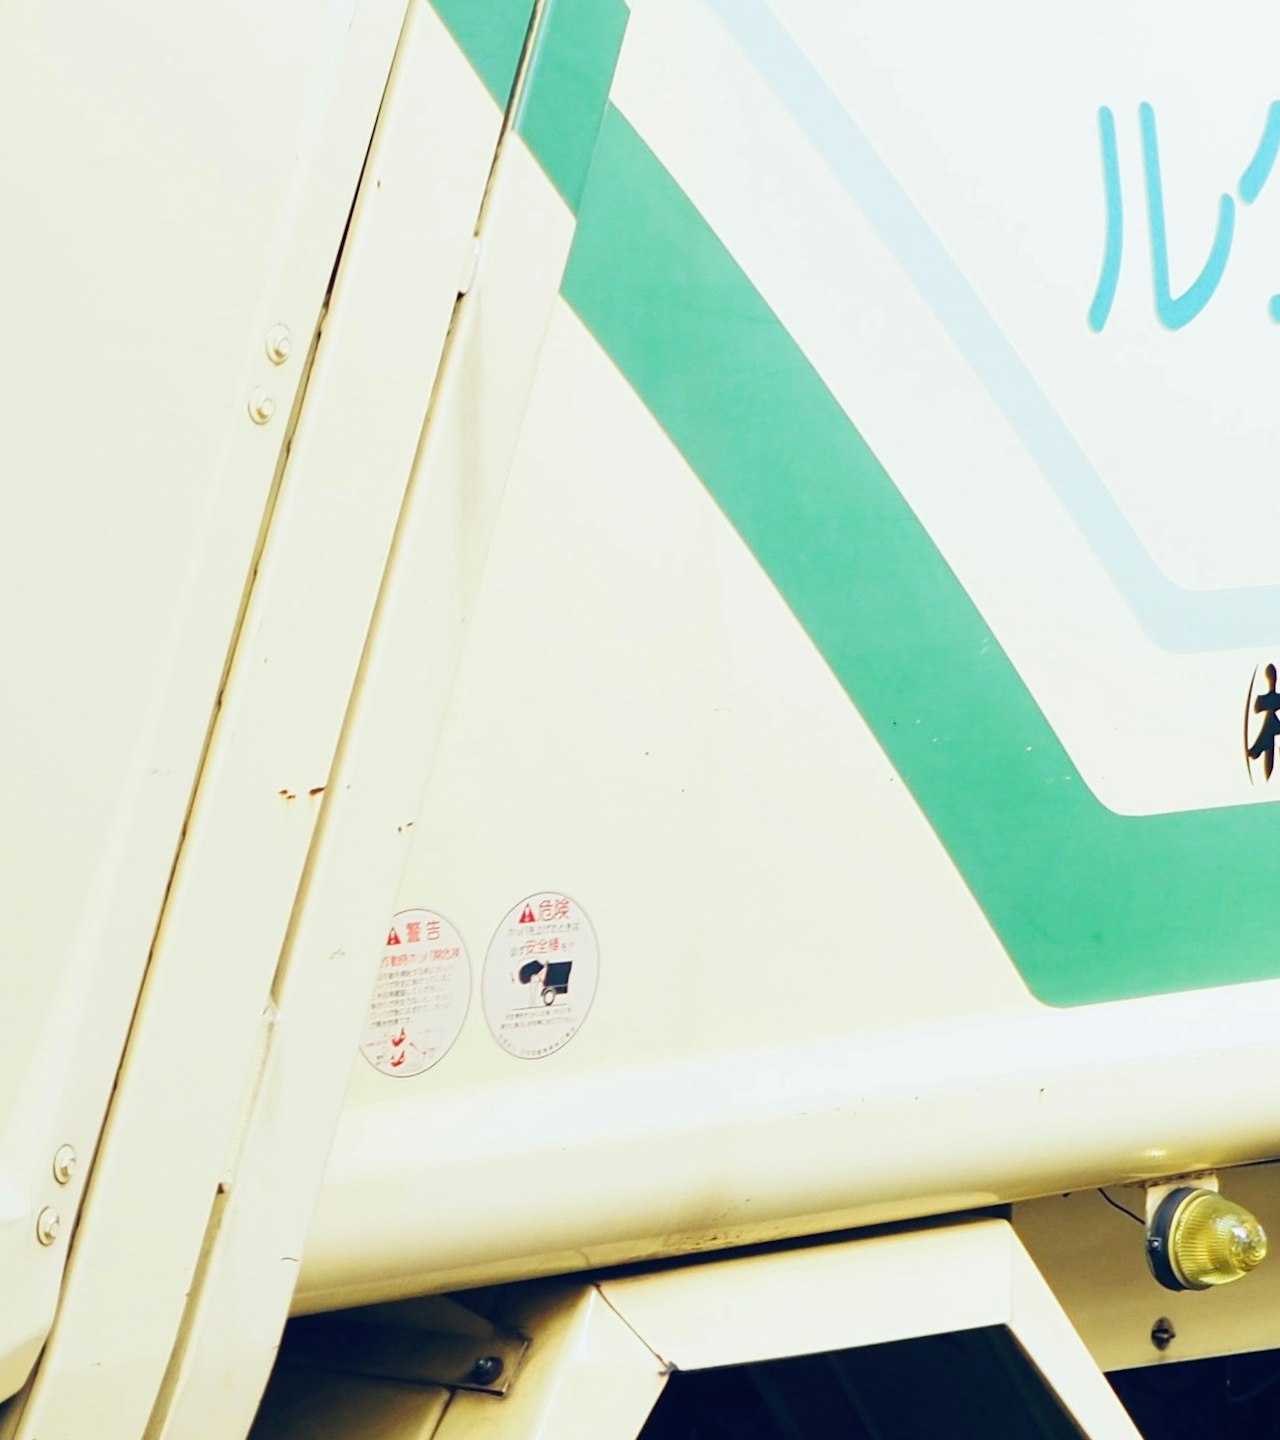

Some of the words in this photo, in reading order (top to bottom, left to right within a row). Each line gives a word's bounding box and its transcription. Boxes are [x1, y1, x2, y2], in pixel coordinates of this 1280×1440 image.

[1088, 100, 1280, 333] ル
[539, 898, 571, 921] 危険
[406, 920, 441, 943] 警告
